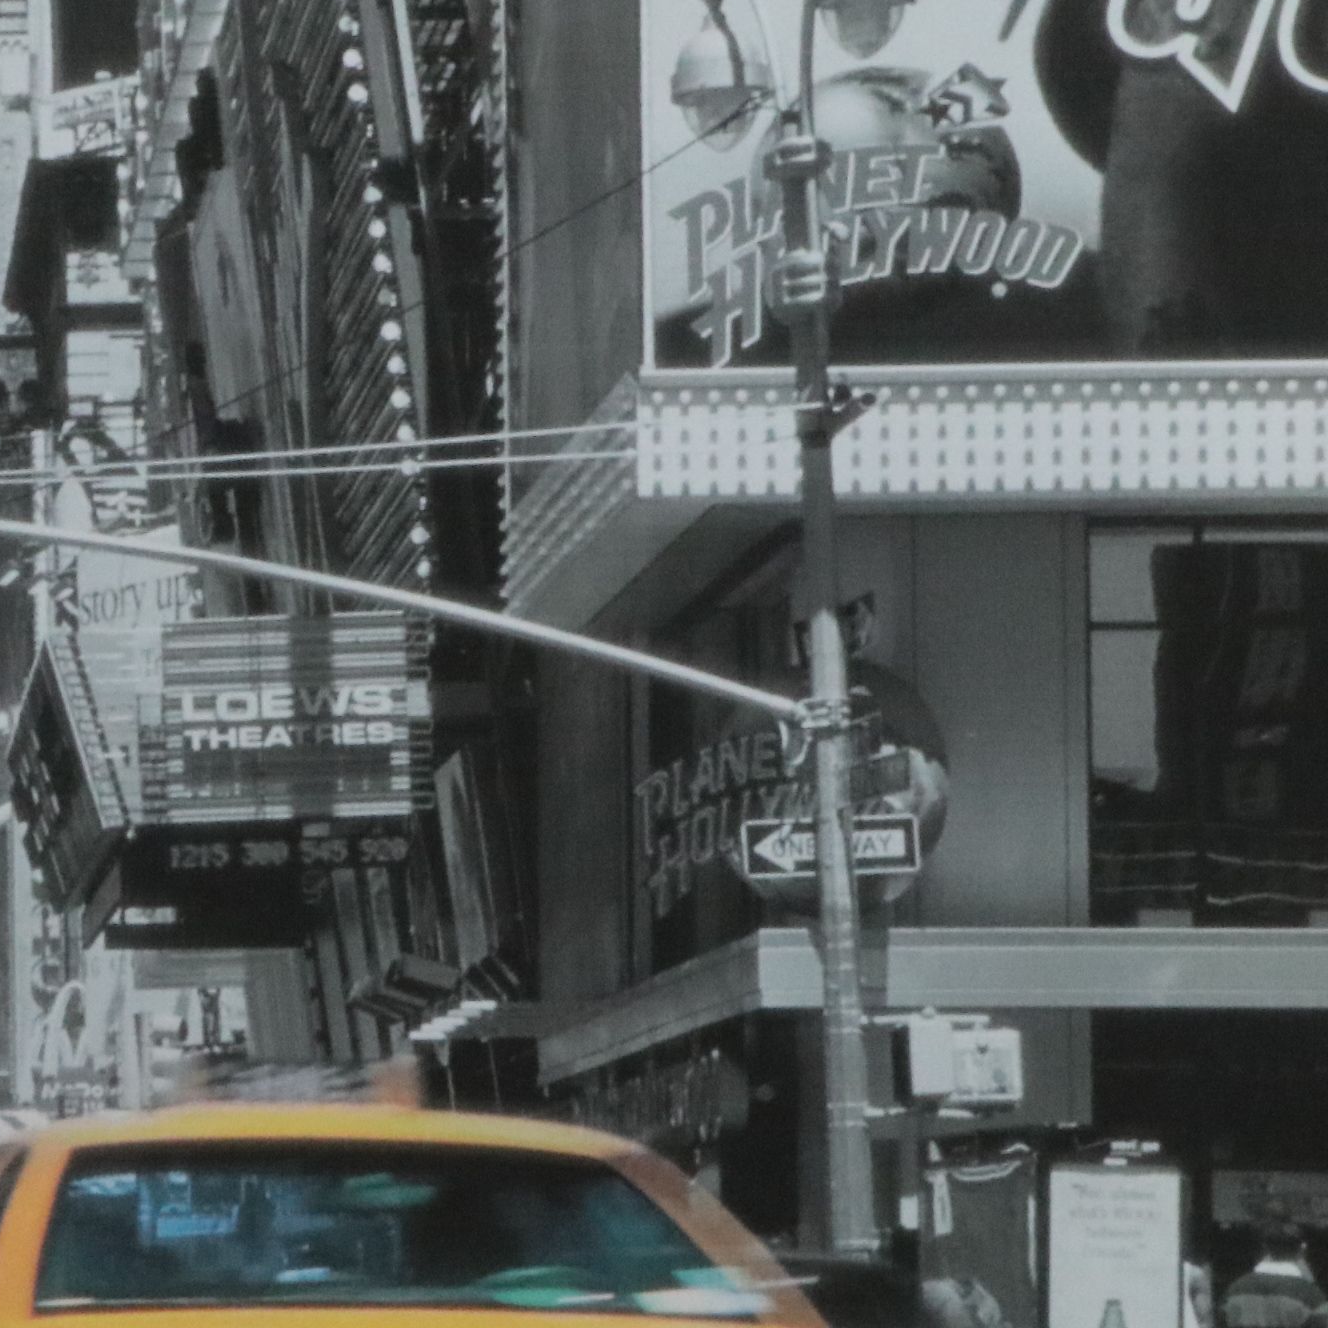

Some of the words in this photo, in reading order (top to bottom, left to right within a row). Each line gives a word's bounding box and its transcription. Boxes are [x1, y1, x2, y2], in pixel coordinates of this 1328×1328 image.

[669, 143, 946, 305] PLNET
[690, 207, 1084, 370] HLYWOOD
[80, 580, 147, 630] story
[182, 683, 394, 722] LOEWS
[183, 721, 395, 752] THEATRES
